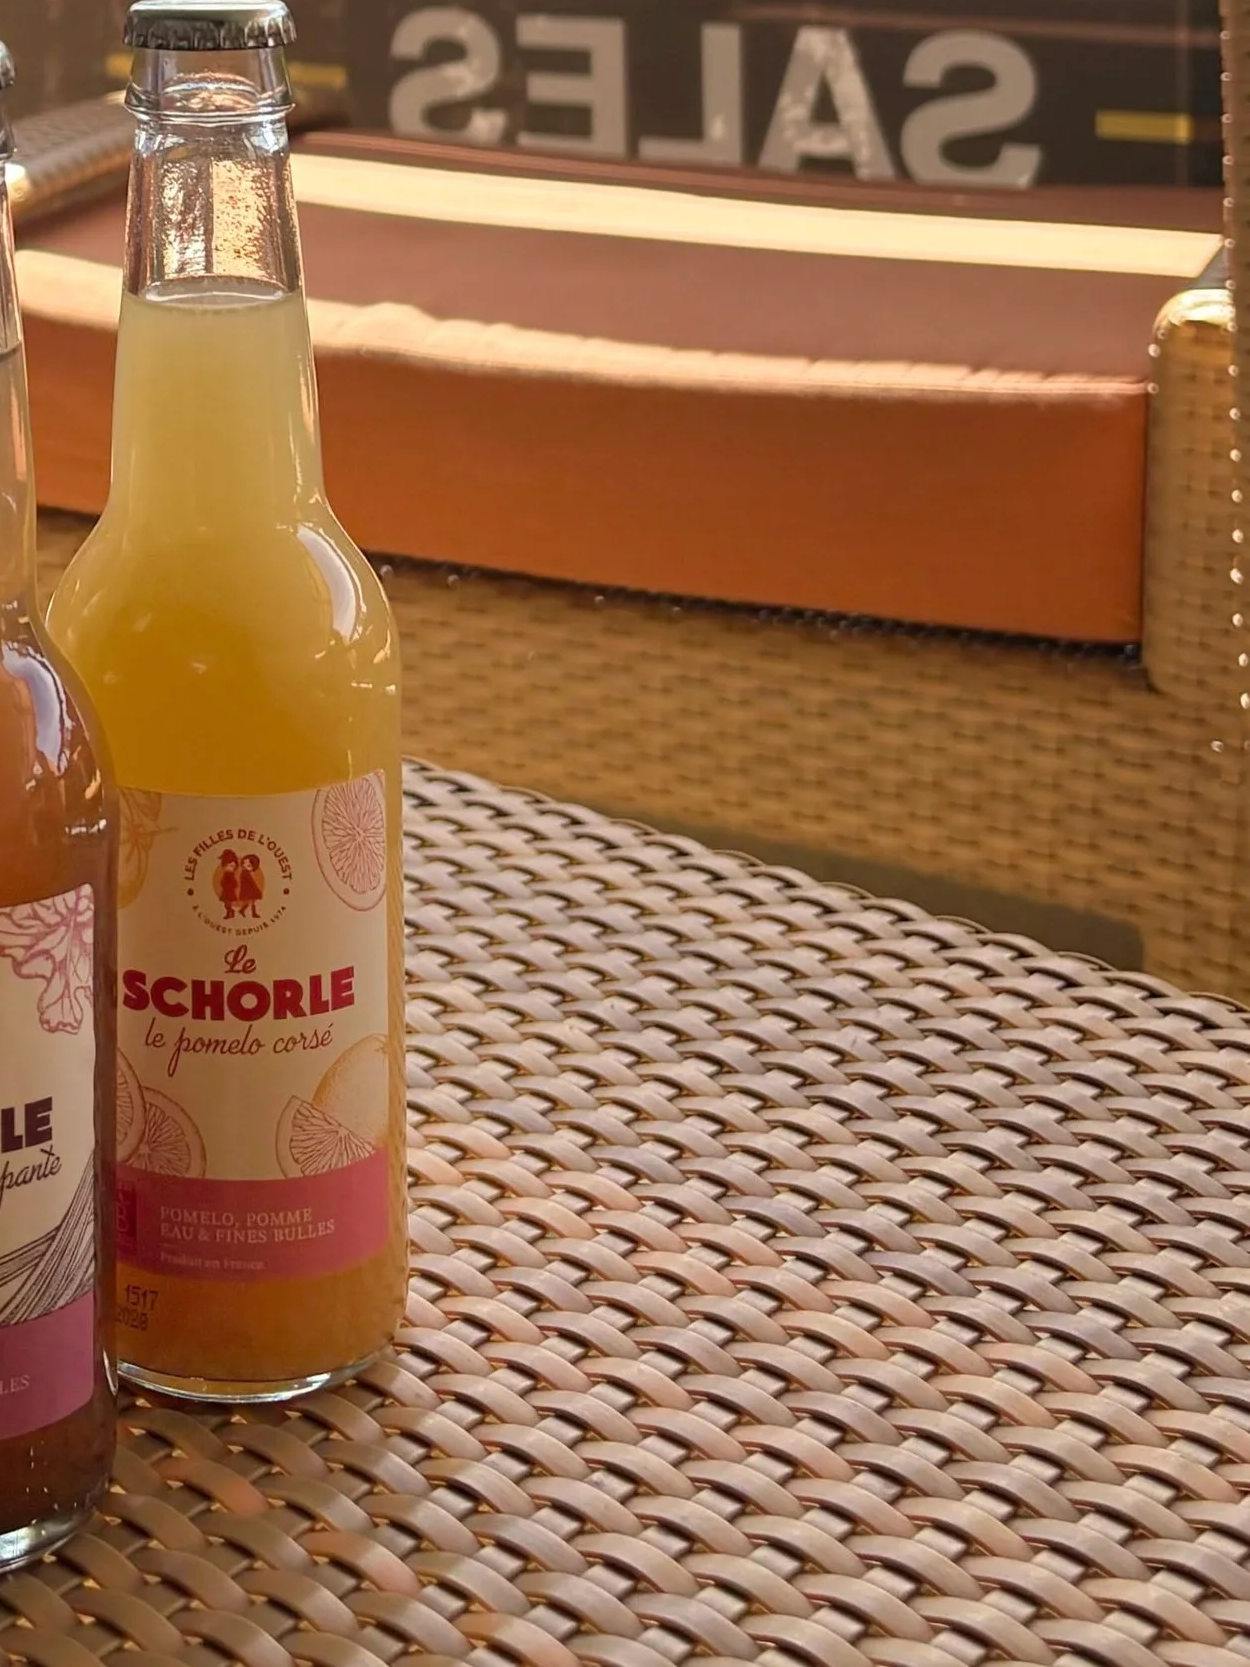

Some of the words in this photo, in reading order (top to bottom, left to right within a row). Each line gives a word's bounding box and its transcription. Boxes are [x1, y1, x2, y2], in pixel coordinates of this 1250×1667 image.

[184, 857, 198, 881] LES
[193, 829, 234, 857] FILLES
[237, 828, 256, 842] DE
[257, 834, 292, 881] L'OUEST
[224, 944, 257, 974] Le
[122, 965, 355, 1022] SCHORLE
[145, 1017, 166, 1048] le
[167, 1024, 265, 1078] pomelo
[273, 1022, 334, 1054] corsé
[160, 1206, 240, 1228] POMELO,
[247, 1207, 313, 1227] POMME
[160, 1223, 193, 1241] EAU
[198, 1230, 210, 1242] &
[215, 1230, 268, 1244] FINES
[273, 1218, 336, 1243] BULLES
